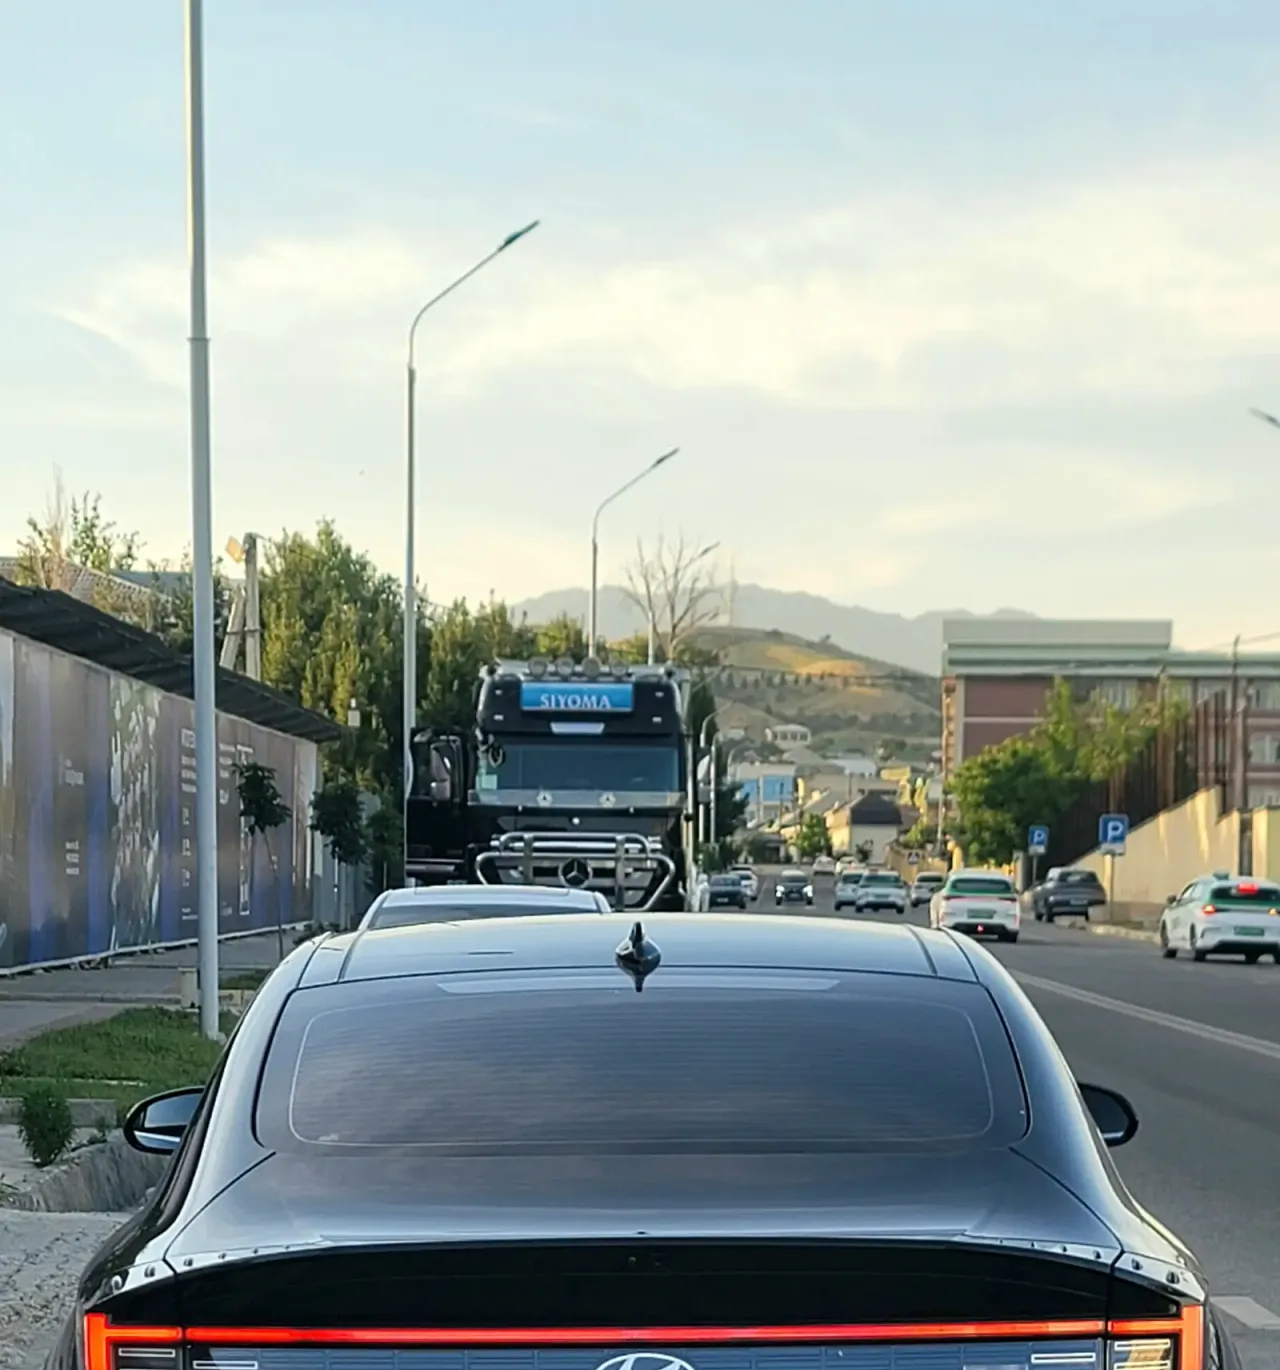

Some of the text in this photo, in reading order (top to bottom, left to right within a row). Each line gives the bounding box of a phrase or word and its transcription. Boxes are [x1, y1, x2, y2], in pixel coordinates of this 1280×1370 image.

[540, 693, 612, 709] SIYOMA
[1033, 829, 1046, 845] P
[1107, 820, 1124, 843] P
